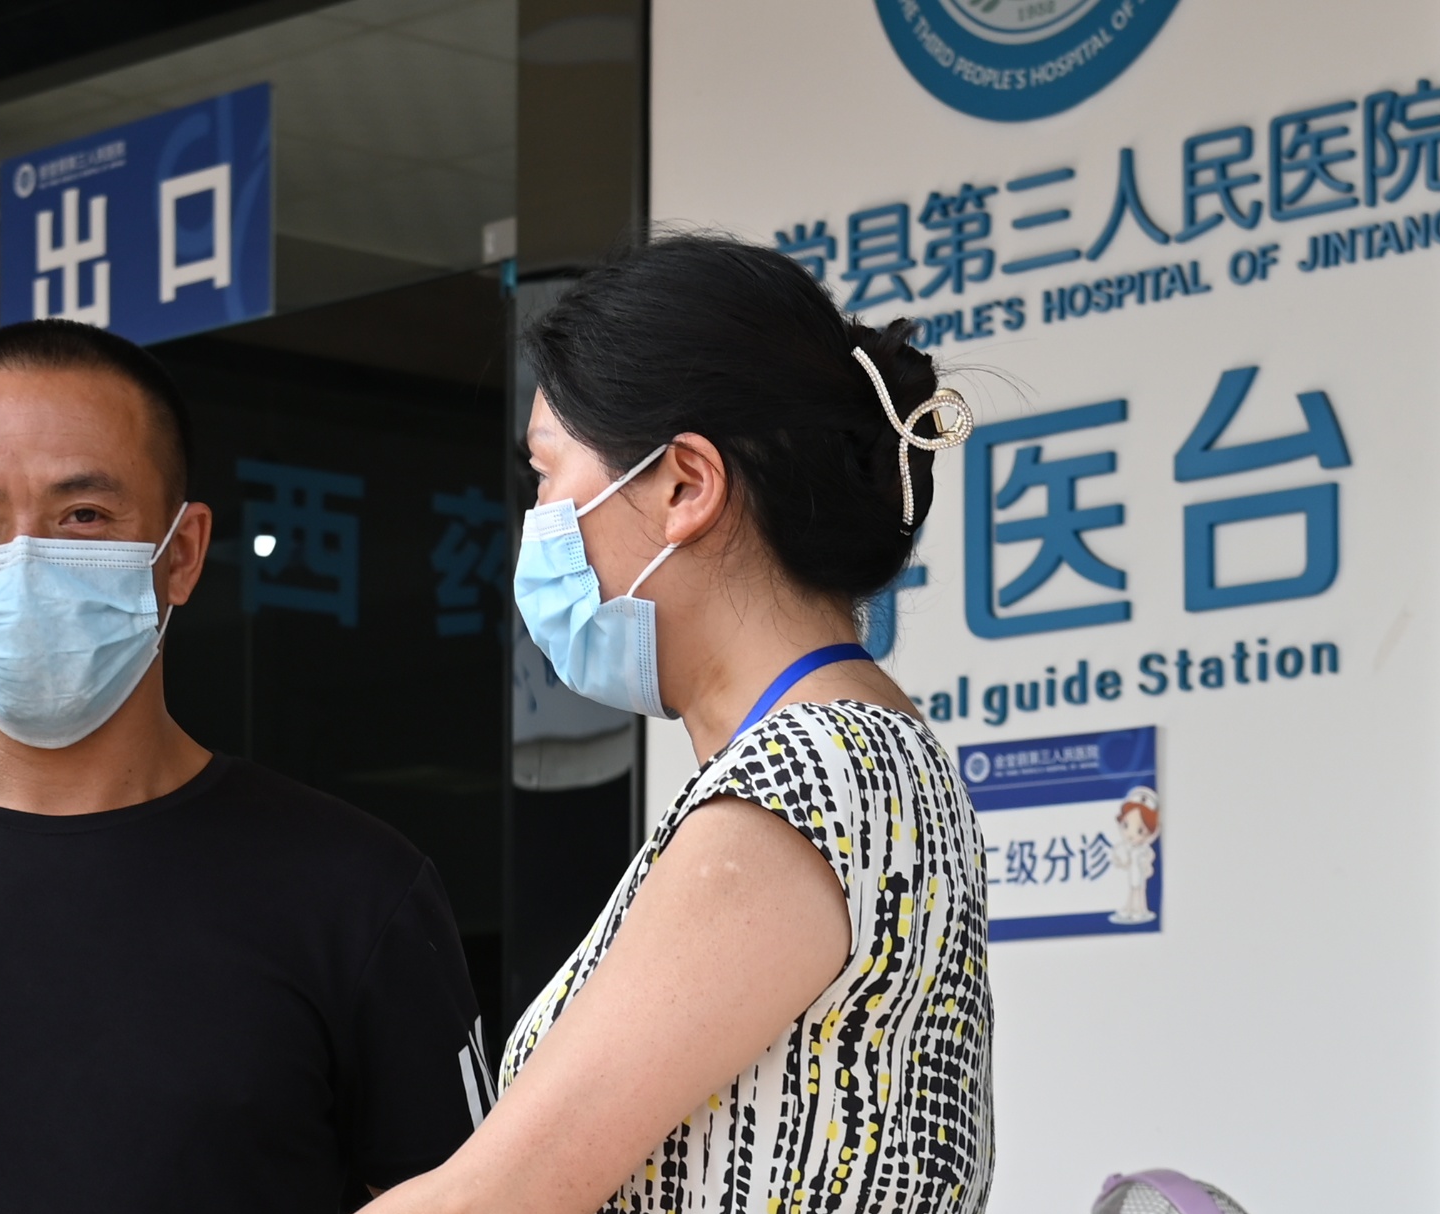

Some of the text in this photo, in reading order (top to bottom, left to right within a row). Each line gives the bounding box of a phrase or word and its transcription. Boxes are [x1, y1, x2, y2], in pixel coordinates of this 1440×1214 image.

[913, 16, 955, 67] THIRD
[1030, 26, 1114, 87] HOSPITAL
[32, 163, 232, 330] 出口
[911, 296, 1026, 350] OPLE'S
[1042, 261, 1212, 325] HOSPITAL
[1228, 243, 1281, 286] OF
[983, 660, 1122, 727] guide
[1137, 638, 1341, 697] Station
[984, 831, 1114, 885] 二级分诊
